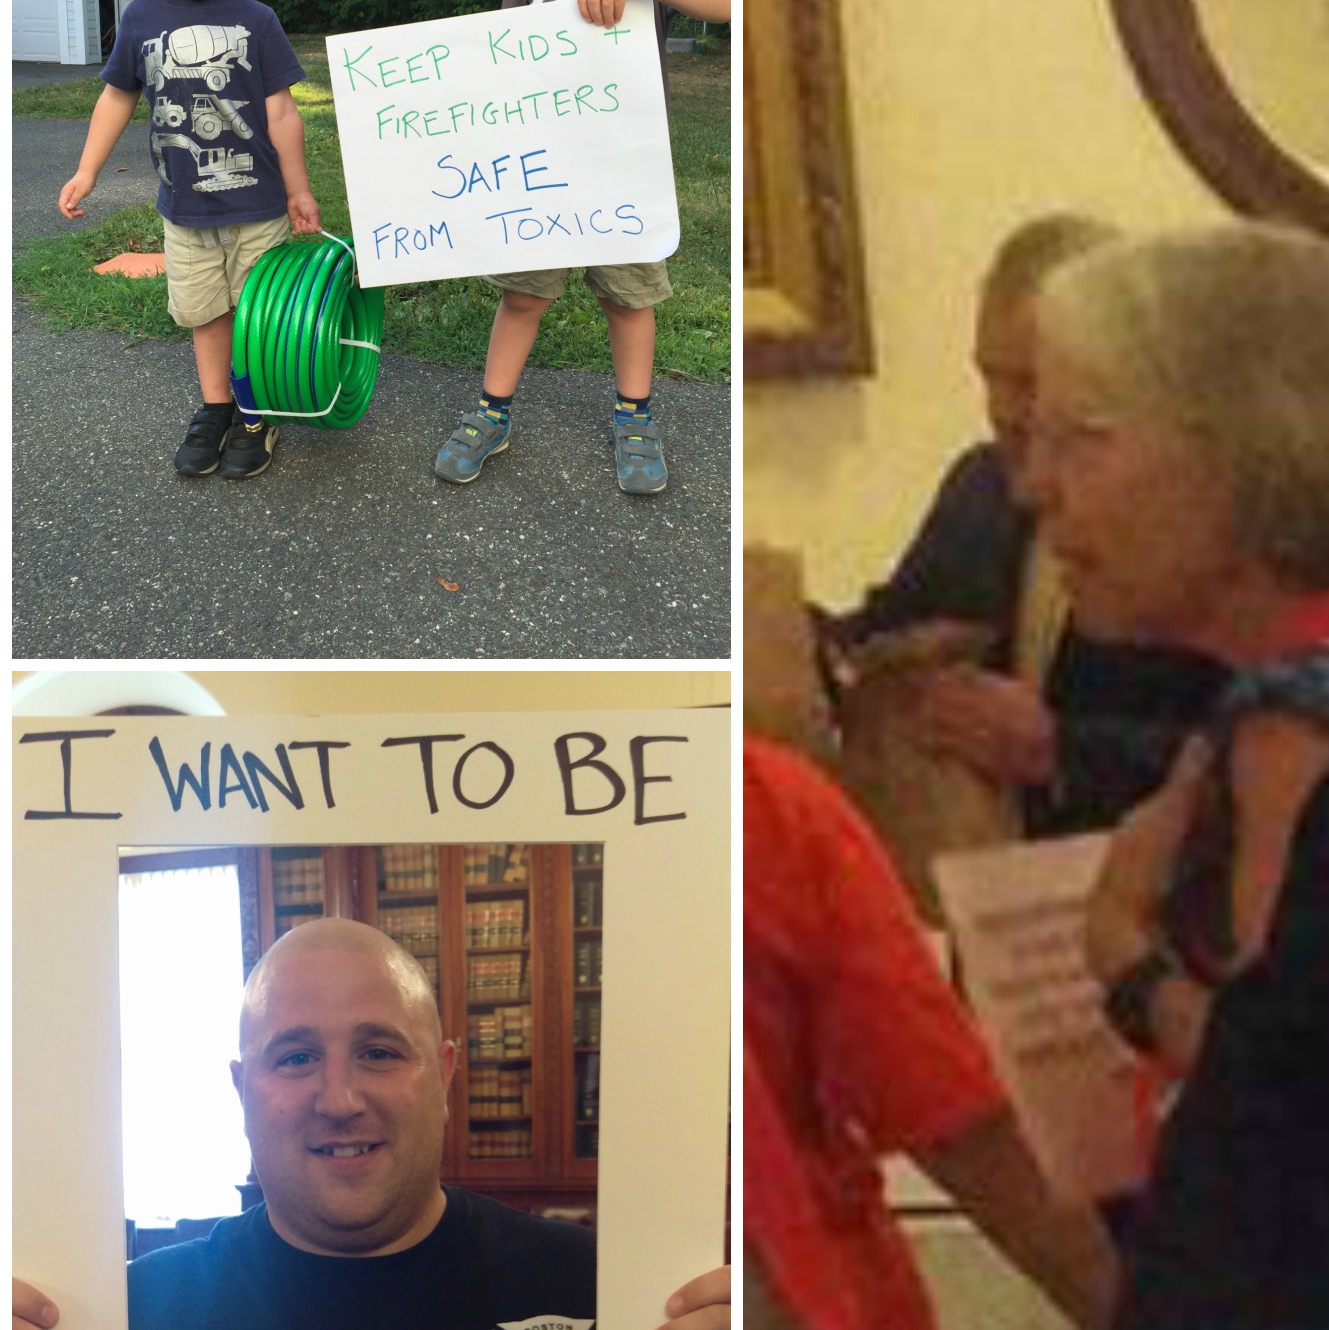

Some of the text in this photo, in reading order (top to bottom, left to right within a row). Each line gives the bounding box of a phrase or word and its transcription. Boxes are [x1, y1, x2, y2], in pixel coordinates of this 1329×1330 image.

[343, 44, 451, 91] KEEP
[487, 29, 578, 65] KIDS
[376, 83, 619, 140] FIREFIGHTERS
[432, 149, 568, 199] SAFE
[373, 204, 644, 260] FROM TOXICS
[19, 729, 689, 826] I WANT TO BE
